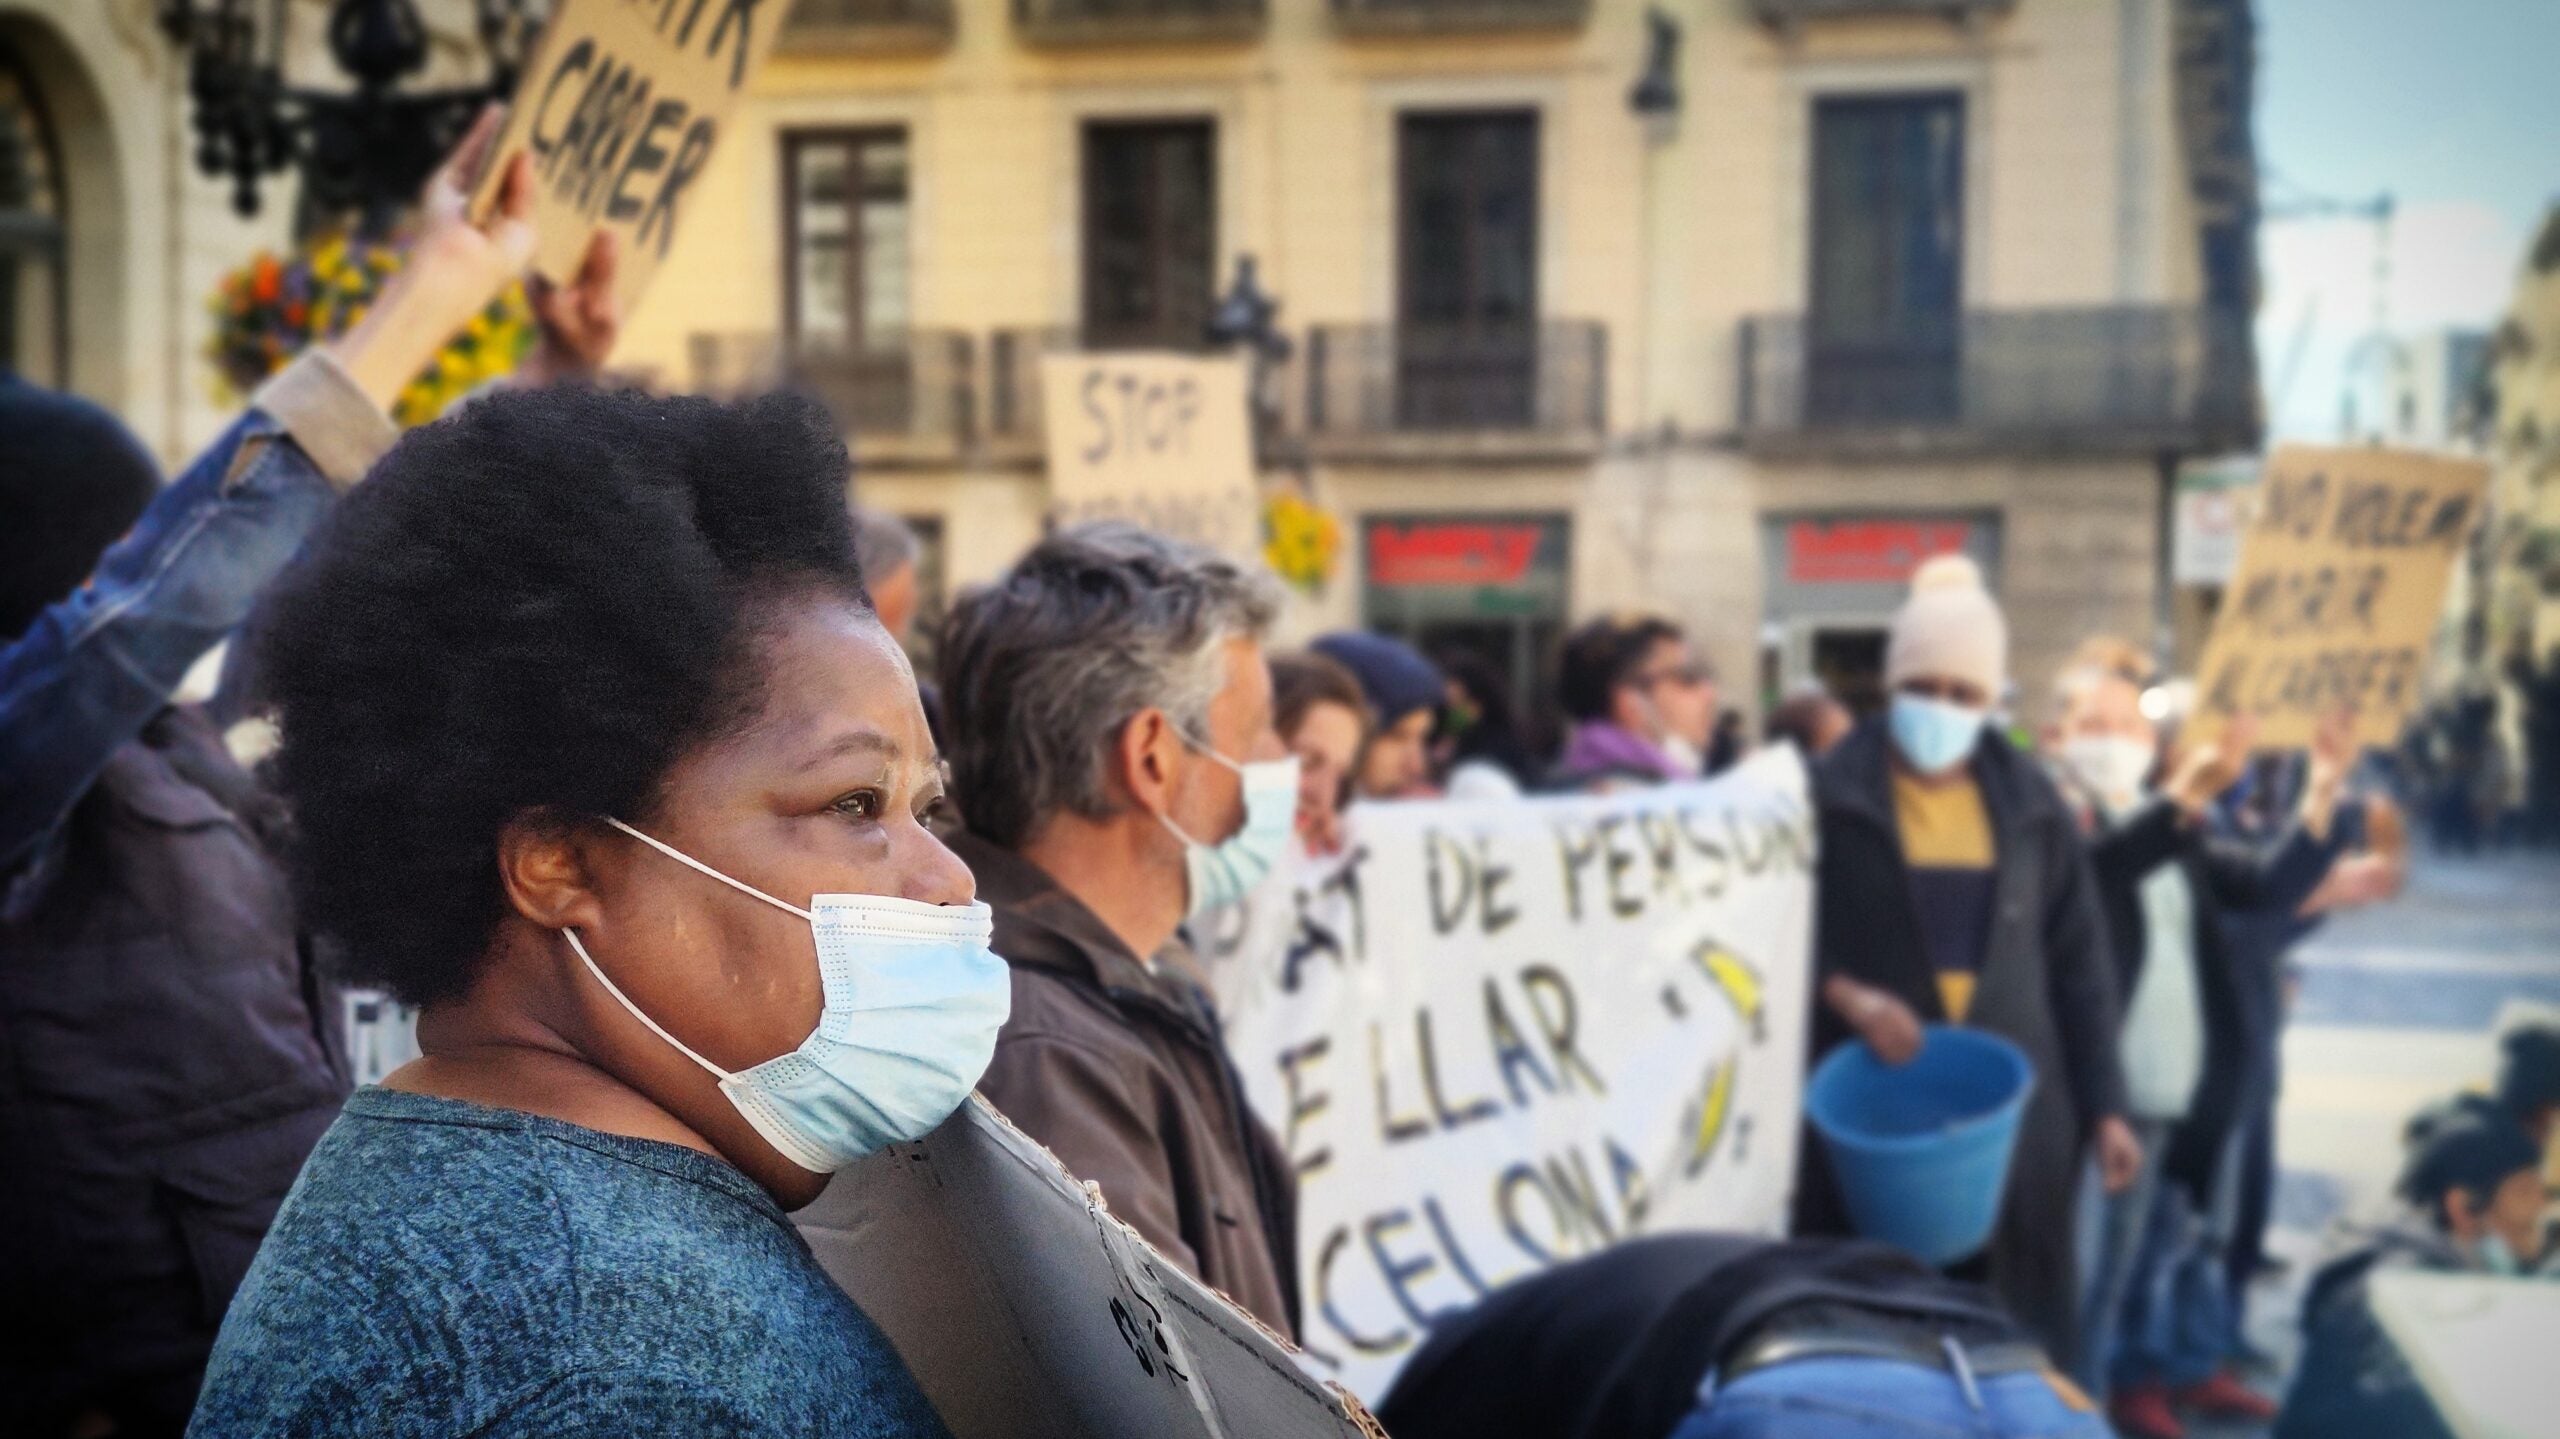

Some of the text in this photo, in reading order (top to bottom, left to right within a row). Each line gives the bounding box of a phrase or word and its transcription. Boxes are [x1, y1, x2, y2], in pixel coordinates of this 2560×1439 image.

[1081, 368, 1200, 464] STOP
[1423, 826, 1520, 937] DE
[1366, 963, 1608, 1144] LLAR
[1300, 1130, 1652, 1372] CELONA
